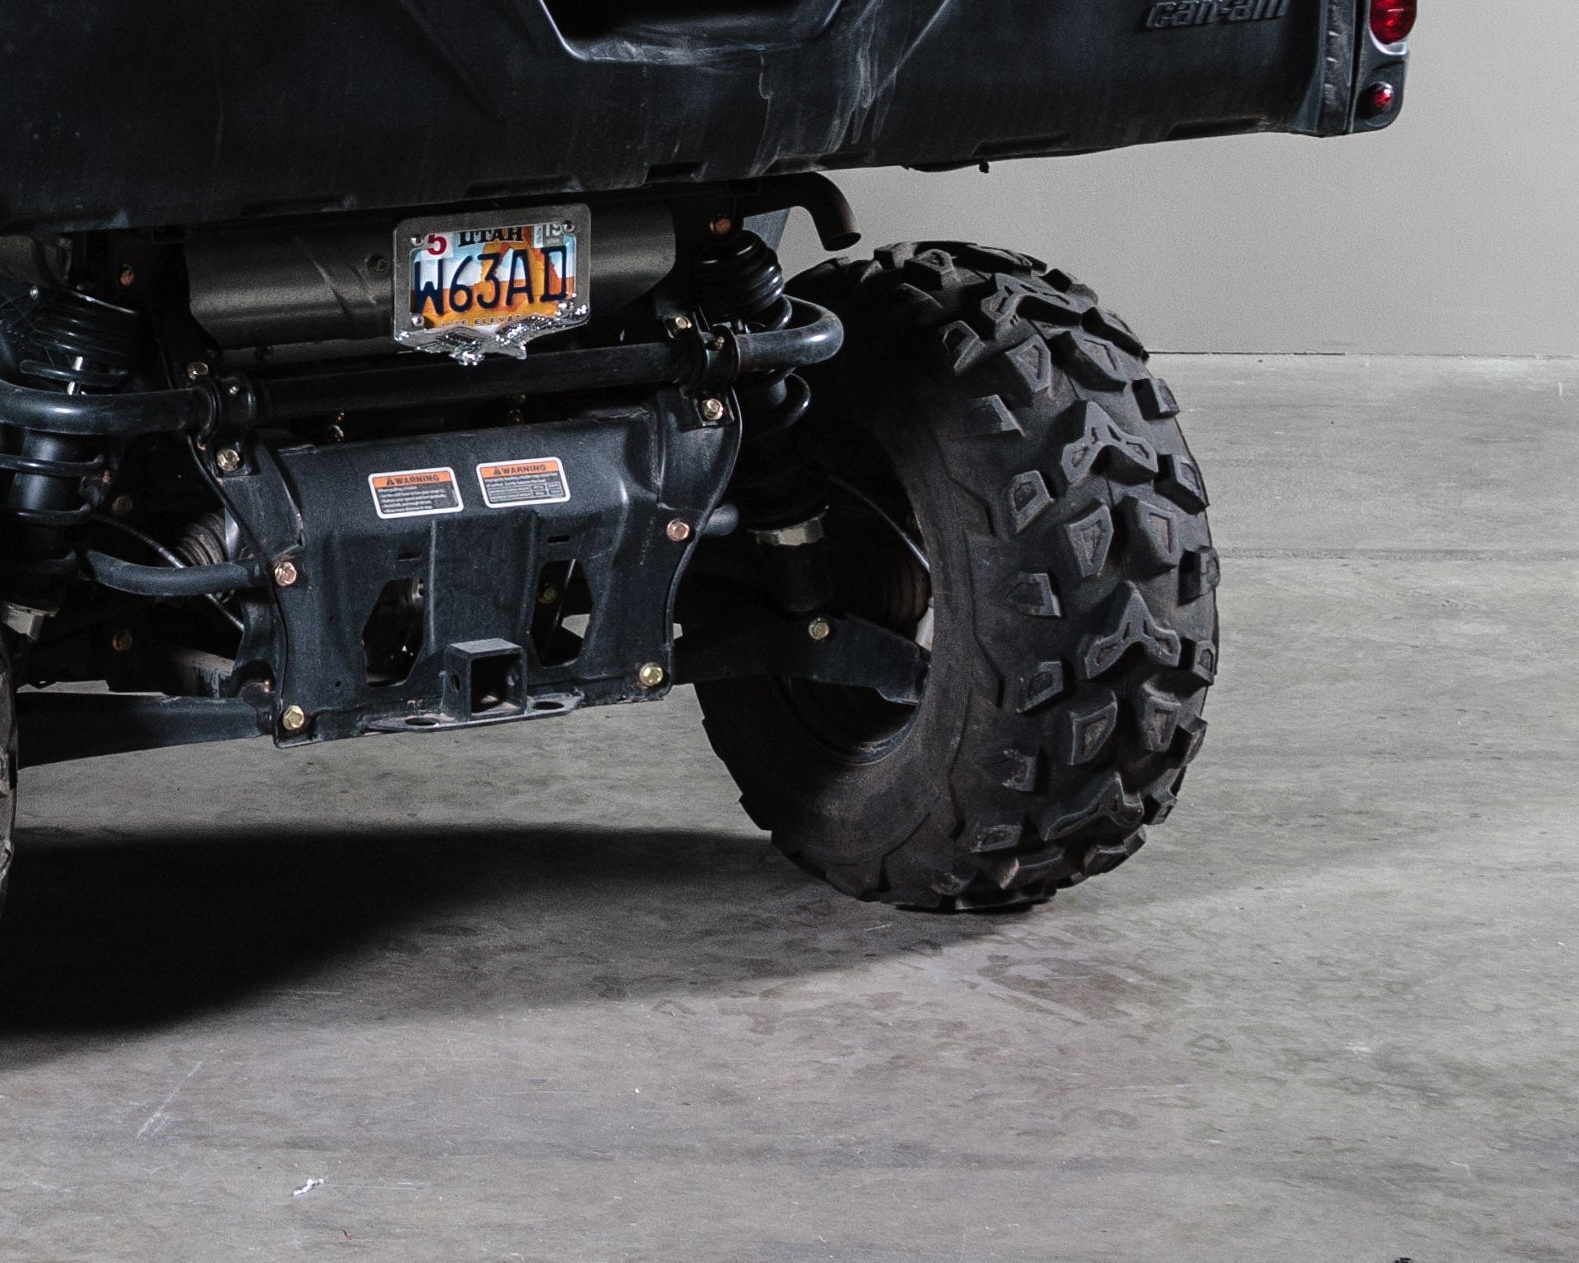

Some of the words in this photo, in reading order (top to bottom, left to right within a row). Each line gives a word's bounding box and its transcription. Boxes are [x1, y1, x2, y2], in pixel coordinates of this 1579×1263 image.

[426, 233, 448, 256] 5
[457, 227, 525, 247] UTAH
[410, 245, 568, 316] W63AD
[503, 463, 547, 475] WARNING
[394, 474, 440, 486] WARNING
